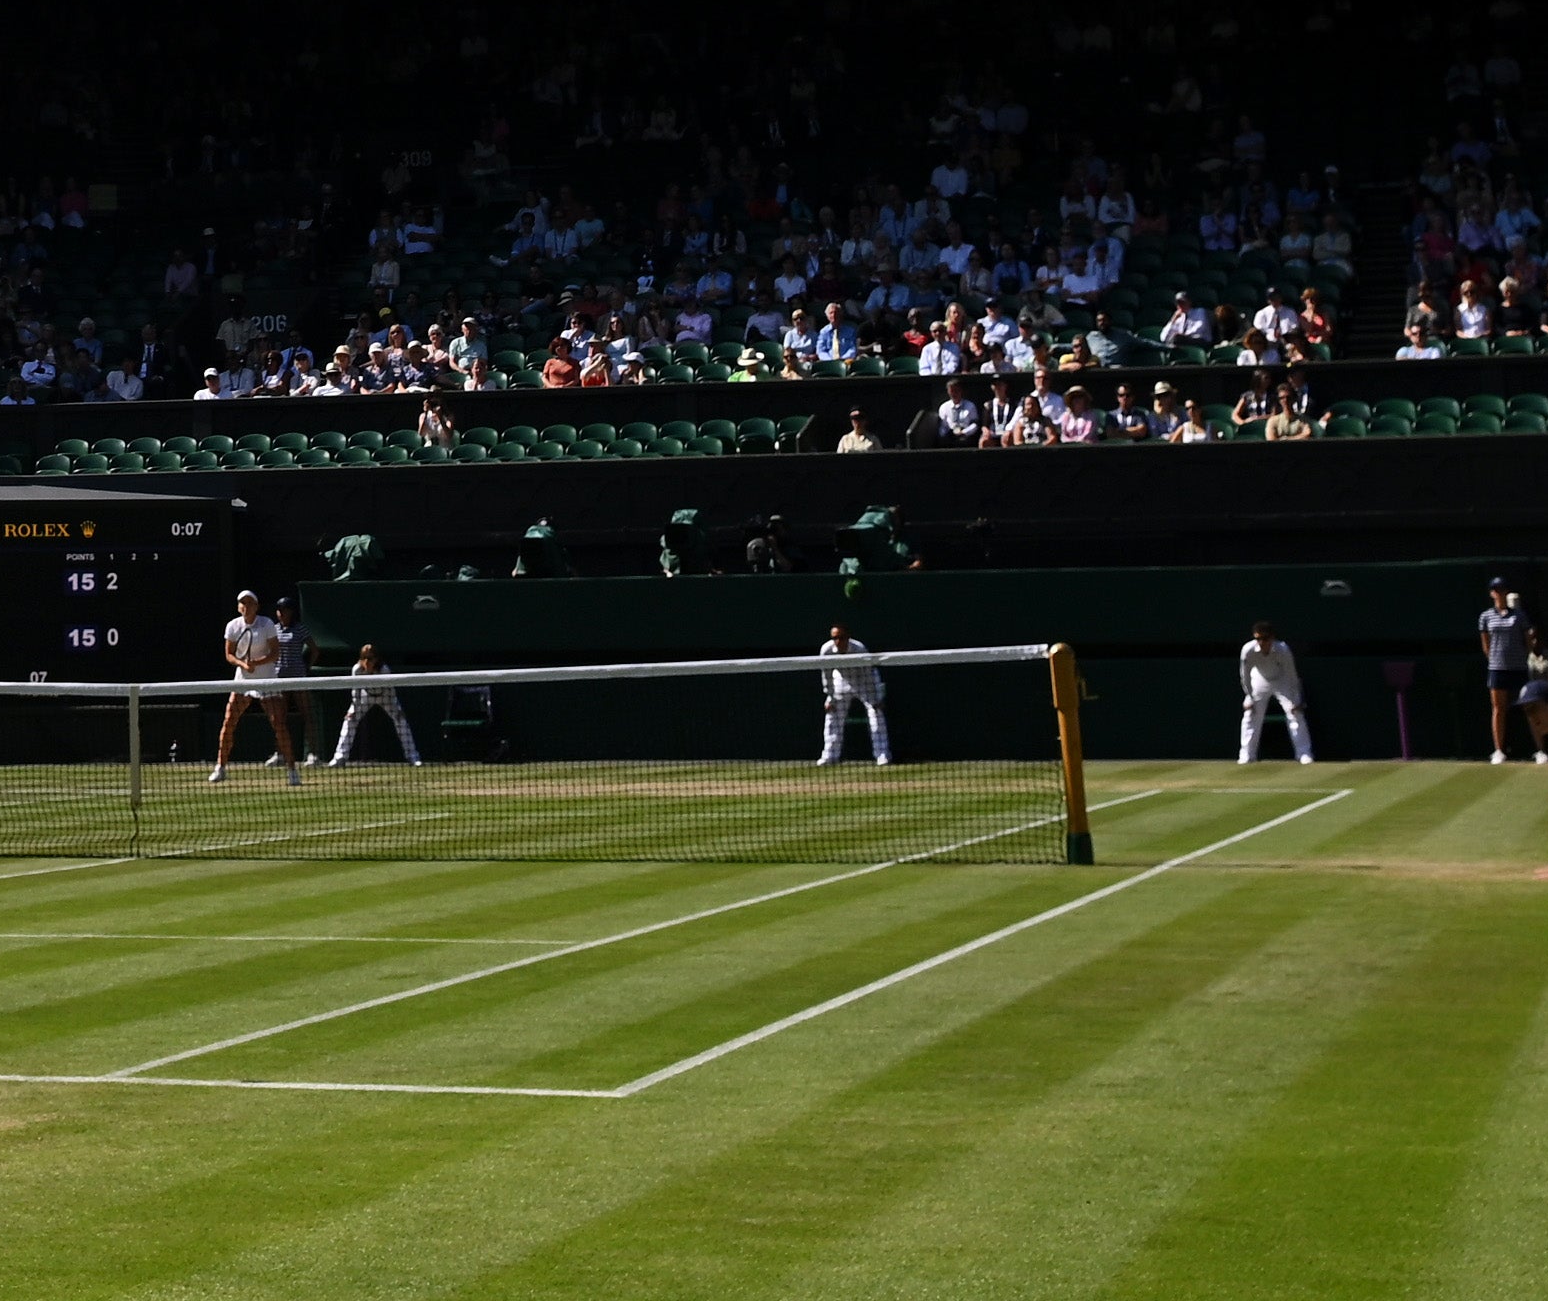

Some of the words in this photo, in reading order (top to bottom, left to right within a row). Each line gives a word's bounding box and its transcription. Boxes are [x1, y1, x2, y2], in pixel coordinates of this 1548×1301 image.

[250, 314, 287, 333] 206
[3, 523, 70, 538] ROLEX
[171, 521, 203, 537] 0:07
[66, 552, 96, 561] POINTS
[67, 573, 96, 592] 15
[106, 572, 119, 591] 2
[68, 628, 96, 647] 15
[106, 628, 120, 647] 0
